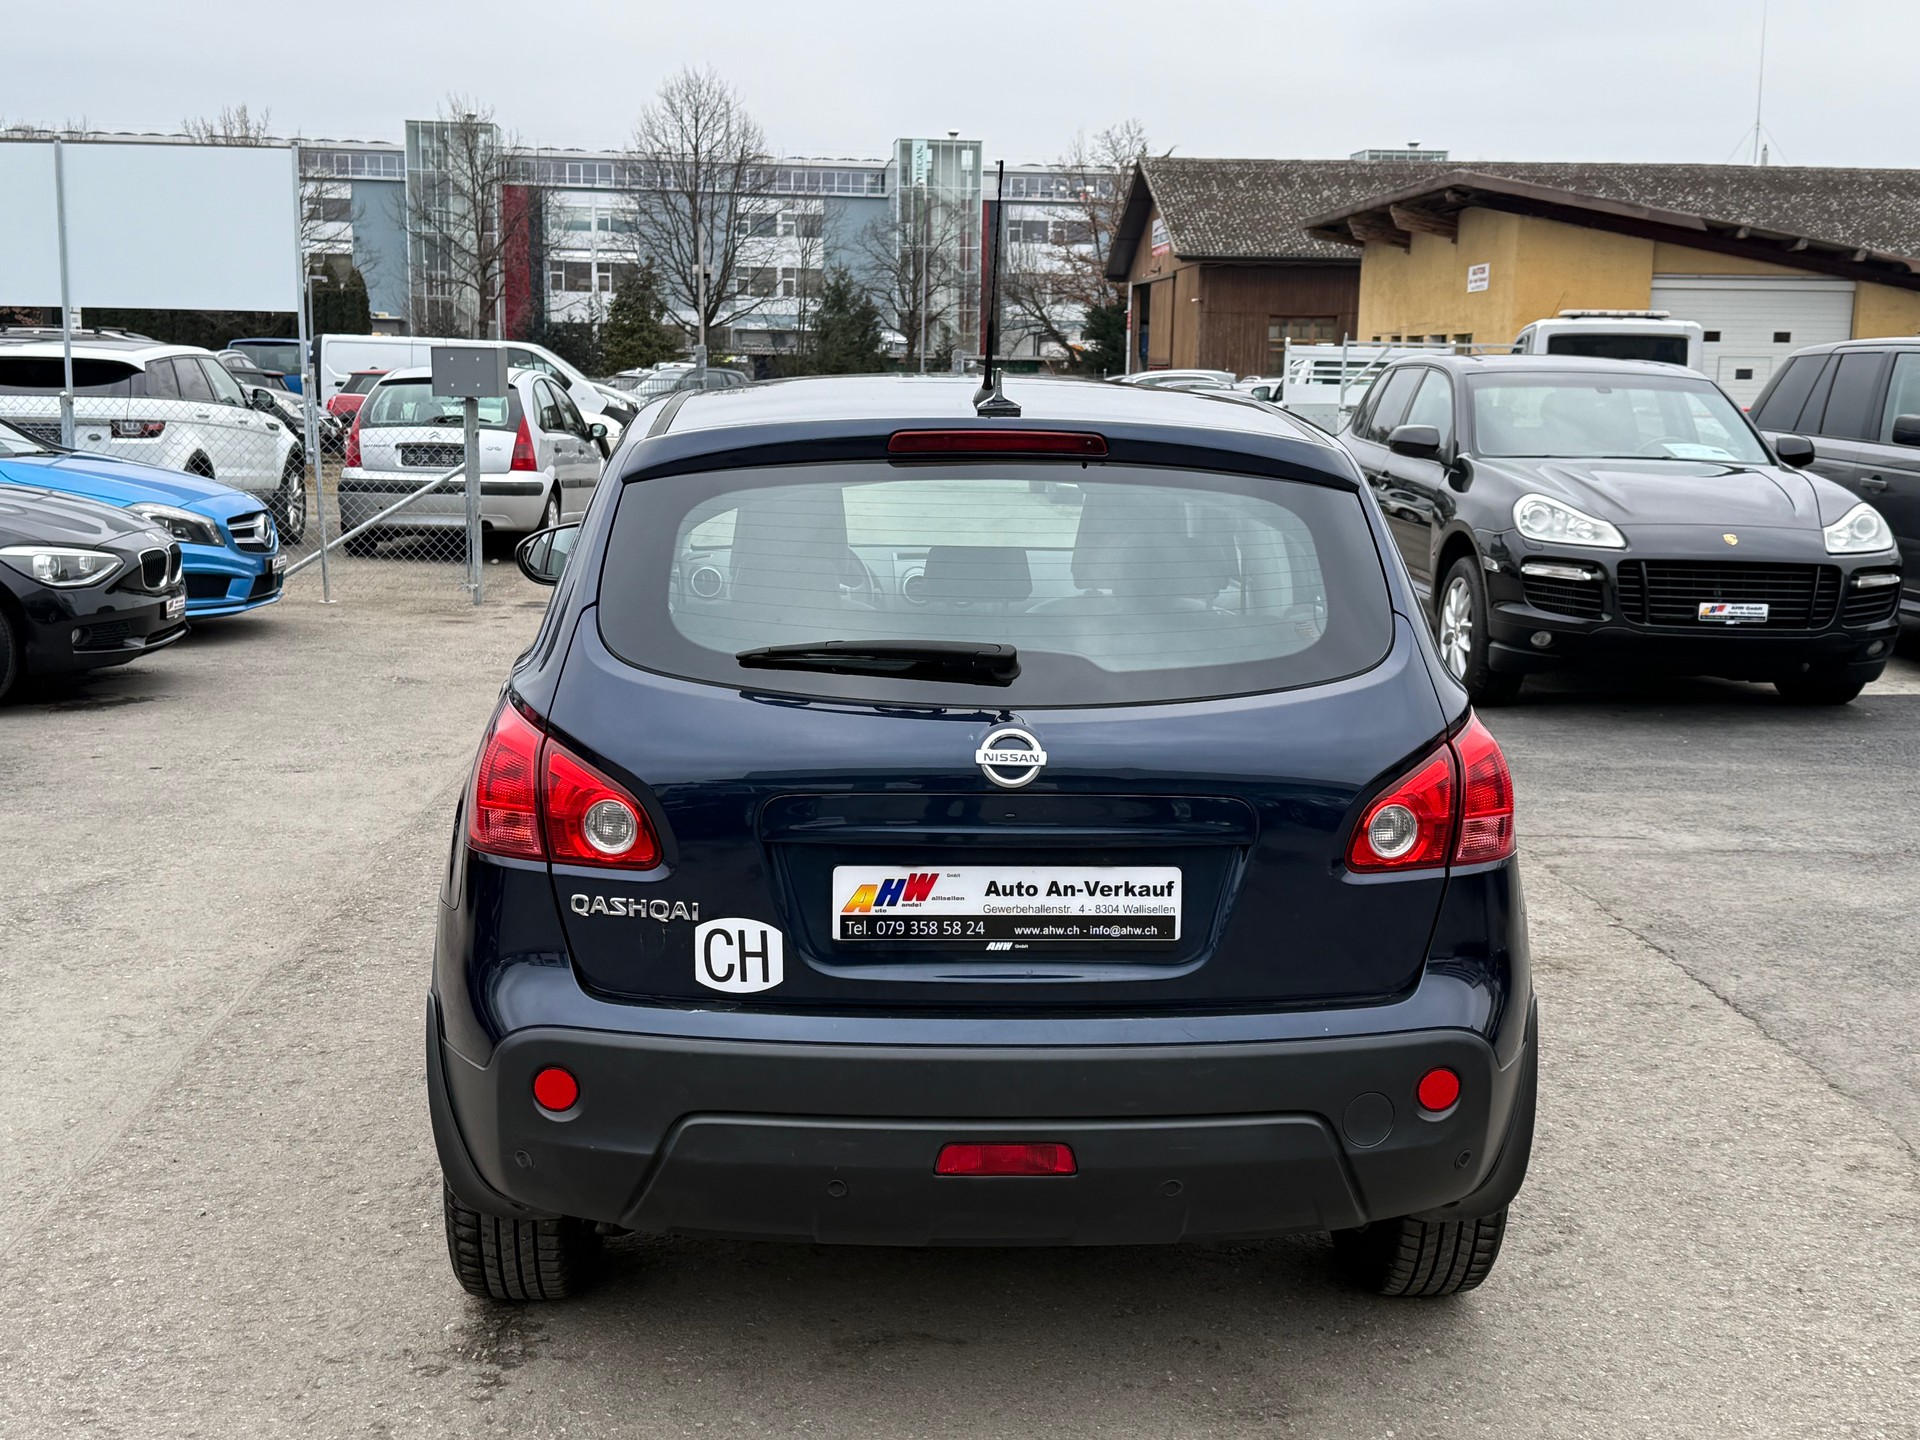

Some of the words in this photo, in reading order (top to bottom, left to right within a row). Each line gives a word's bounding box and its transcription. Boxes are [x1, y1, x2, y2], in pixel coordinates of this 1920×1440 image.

[983, 752, 1040, 763] NISSAN
[841, 873, 940, 913] AHW
[984, 880, 1039, 897] Auto
[1045, 880, 1175, 897] An-Verkauf
[570, 893, 700, 923] QASHQAI
[982, 904, 1073, 914] Gewerbehallenstr.
[1078, 904, 1085, 914] 4
[1094, 904, 1120, 914] 8304
[1122, 904, 1176, 914] Wallisellen
[845, 920, 872, 935] Tel.
[876, 921, 905, 935] 079
[909, 921, 938, 935] 358
[942, 921, 962, 935] 58
[966, 921, 985, 935] 24
[1014, 925, 1080, 935] www.ahw.ch
[1089, 925, 1158, 937] info@ahw.ch
[985, 941, 1013, 951] AHW
[703, 928, 770, 983] CH
